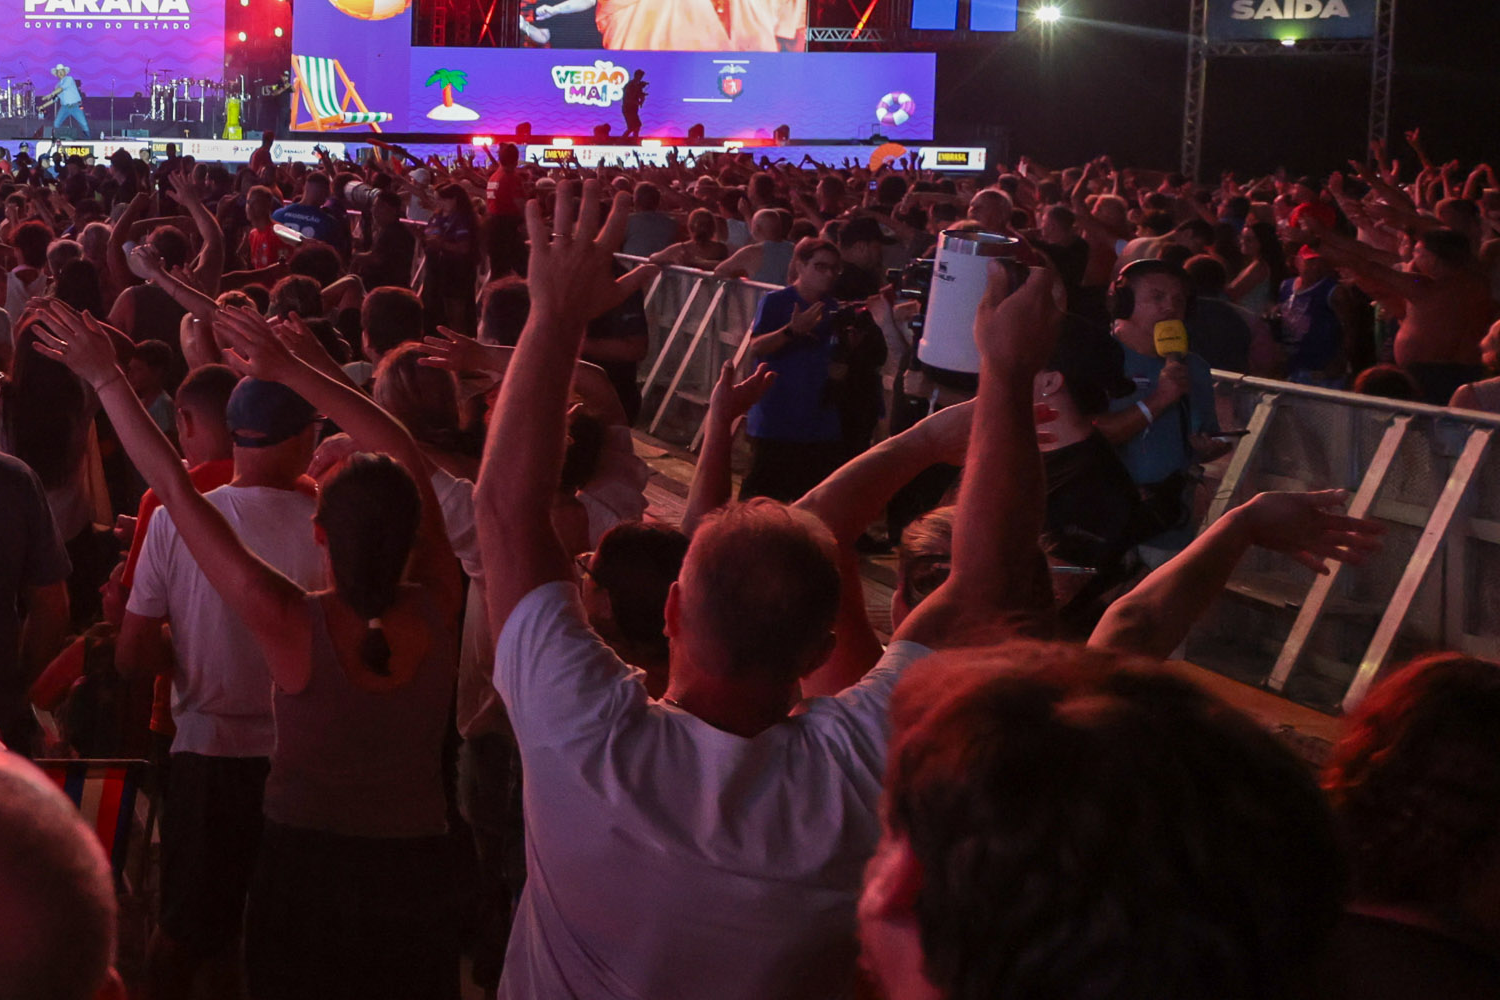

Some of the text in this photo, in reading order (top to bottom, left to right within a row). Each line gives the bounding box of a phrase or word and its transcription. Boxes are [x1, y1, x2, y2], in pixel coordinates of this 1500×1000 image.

[24, 21, 191, 30] GOVERNO DO ESTADO
